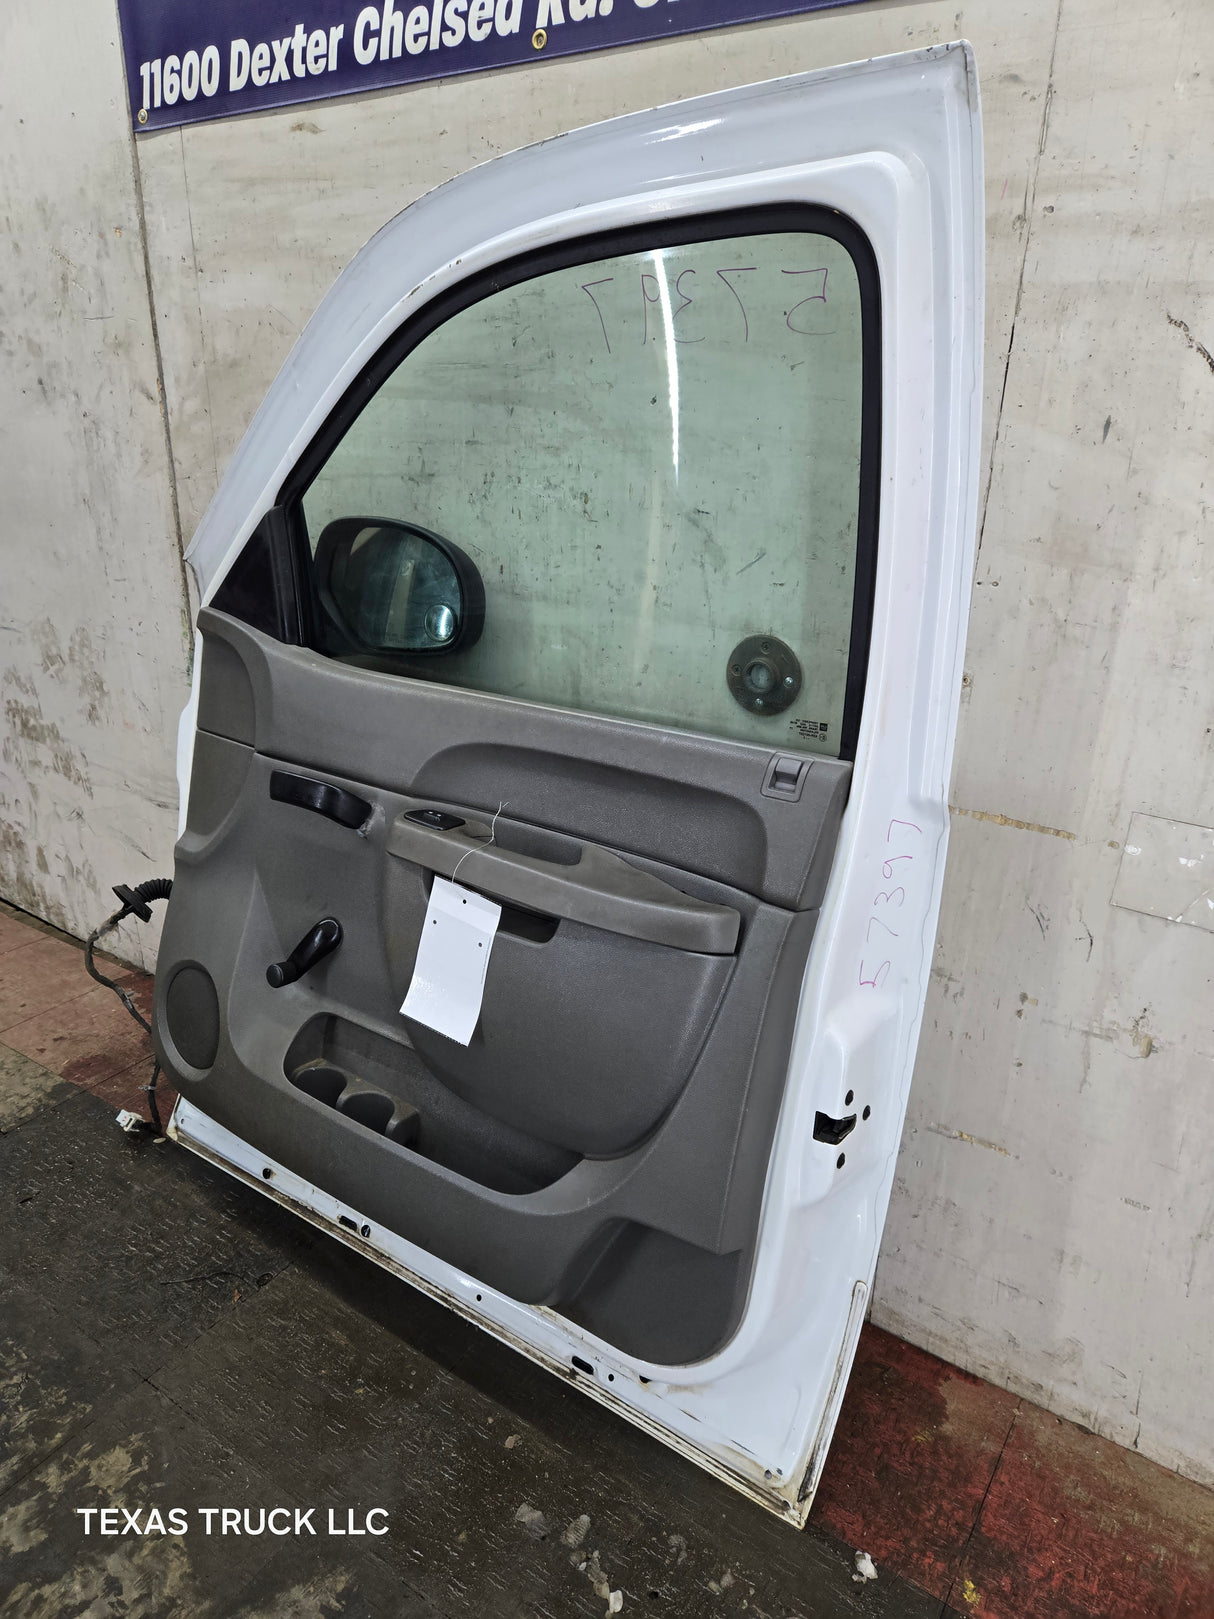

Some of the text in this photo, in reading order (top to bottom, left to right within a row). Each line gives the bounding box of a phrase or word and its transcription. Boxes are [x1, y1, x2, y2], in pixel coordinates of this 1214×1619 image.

[140, 45, 220, 110] 11600
[229, 24, 344, 92] Dexter
[859, 819, 923, 989] 57397
